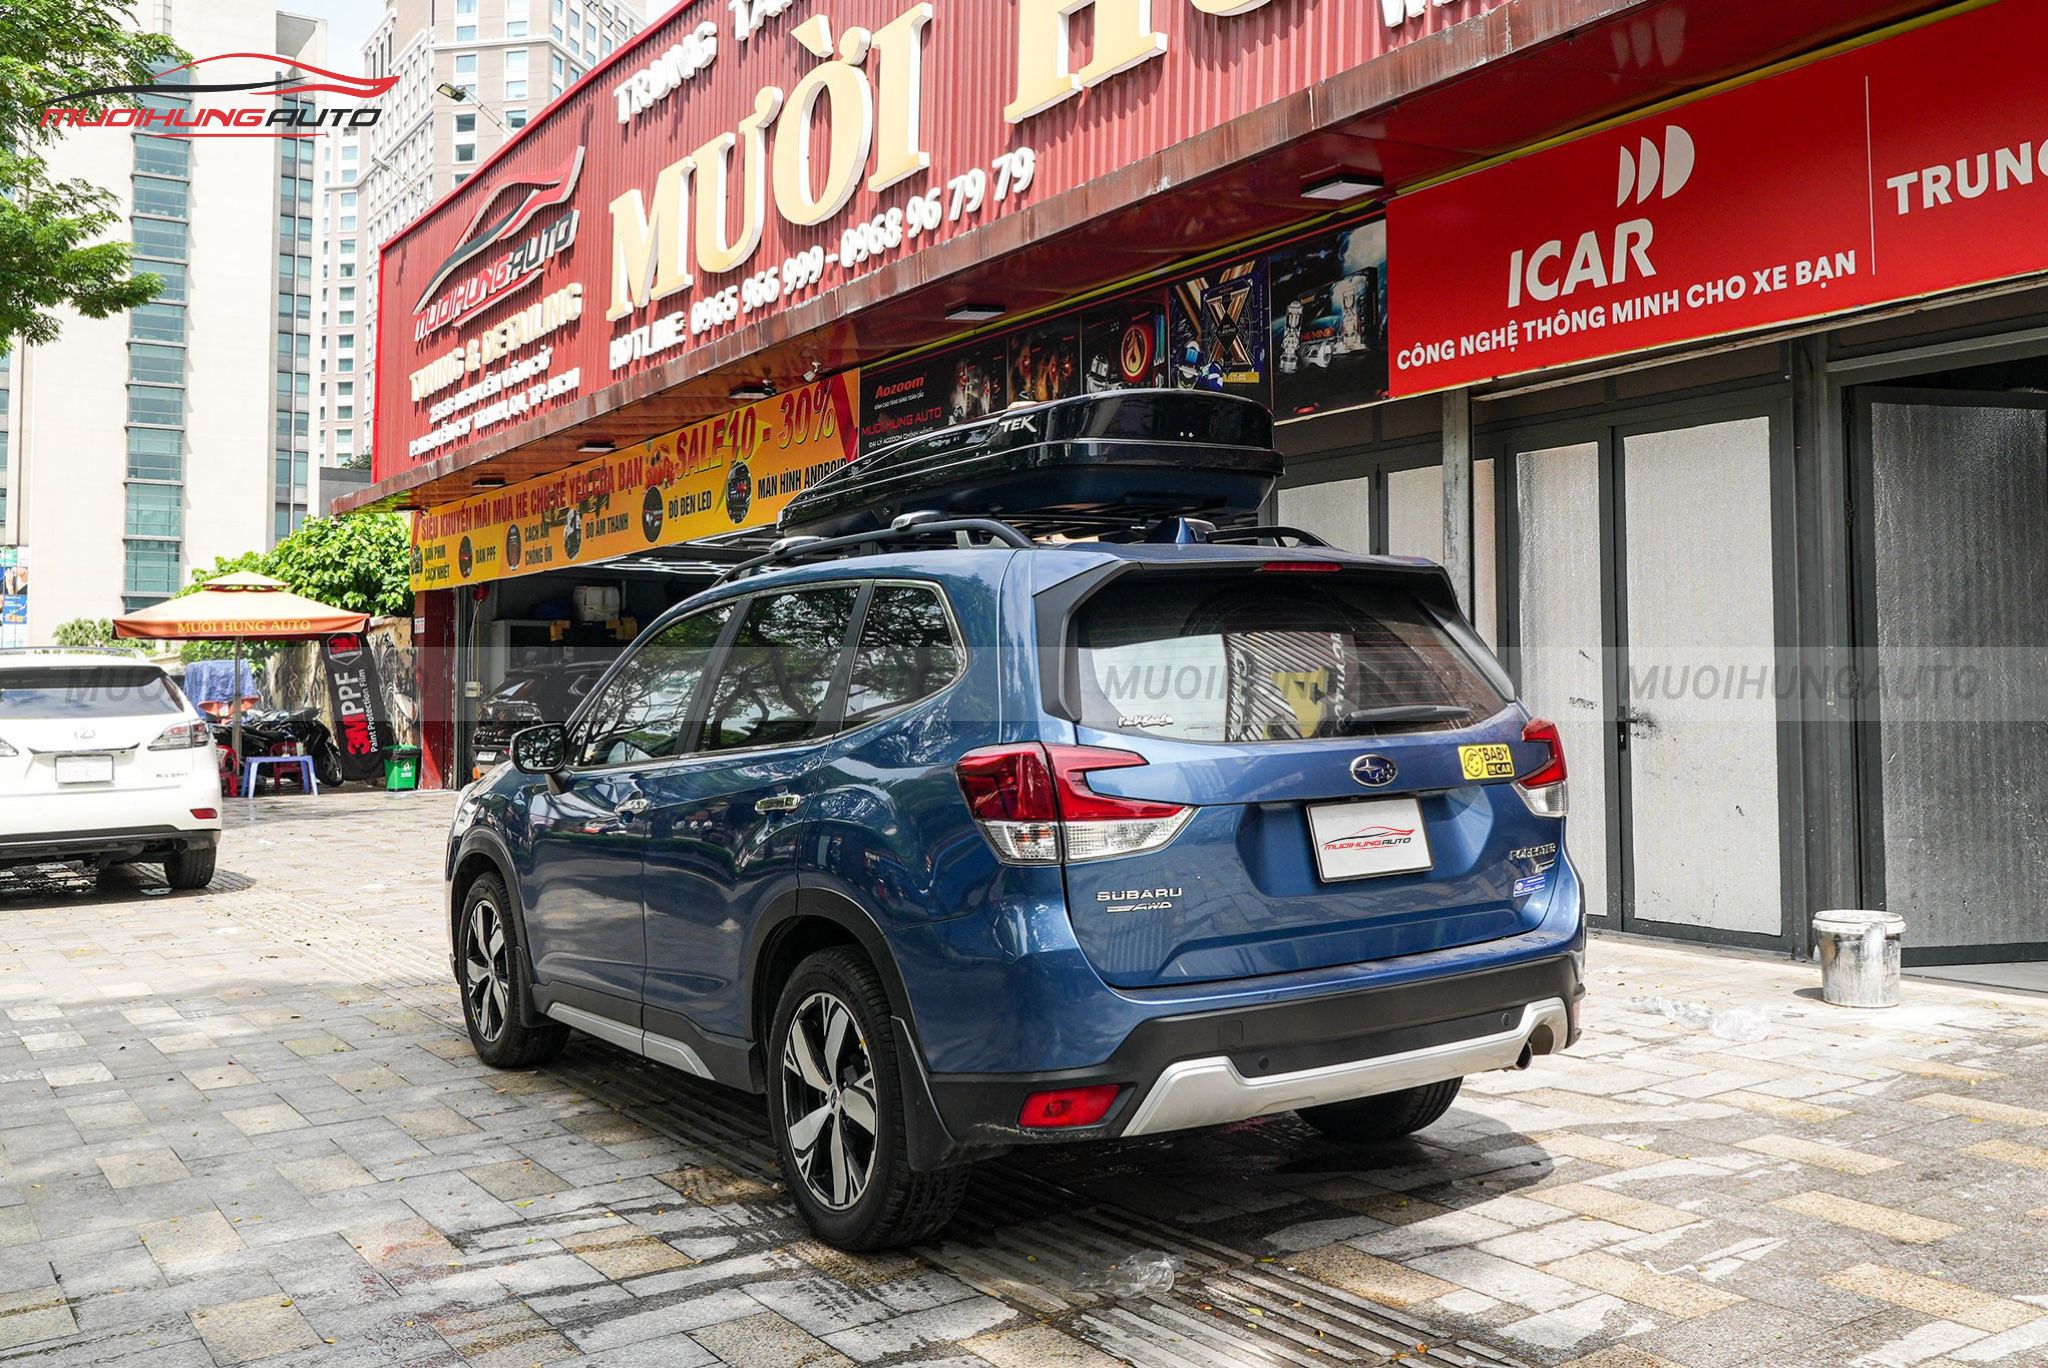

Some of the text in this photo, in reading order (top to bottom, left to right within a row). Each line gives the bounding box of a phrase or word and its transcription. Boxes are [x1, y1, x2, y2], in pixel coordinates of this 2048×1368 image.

[613, 21, 718, 124] TRUNG
[605, 2, 933, 321] MƯỜI
[690, 284, 739, 335] 0965
[742, 265, 780, 314] 966
[906, 187, 942, 238] 96
[948, 168, 986, 221] 79
[992, 146, 1035, 201] 79
[1506, 218, 1657, 309] ICAR
[1396, 250, 1857, 371] CÔNG NGHỆ THÔNG MINH CHO XE BẠN
[874, 376, 925, 400] Aozoom
[675, 418, 726, 481] SALE
[777, 378, 837, 450] 30%
[1000, 415, 1037, 433] TEK
[697, 490, 712, 512] LED
[270, 620, 311, 631] AUTO
[334, 672, 364, 715] PPF
[359, 668, 379, 753] Paint Protection Film
[1482, 747, 1509, 762] BABY
[1488, 763, 1513, 775] IN CAR
[1096, 887, 1183, 901] SUBARU
